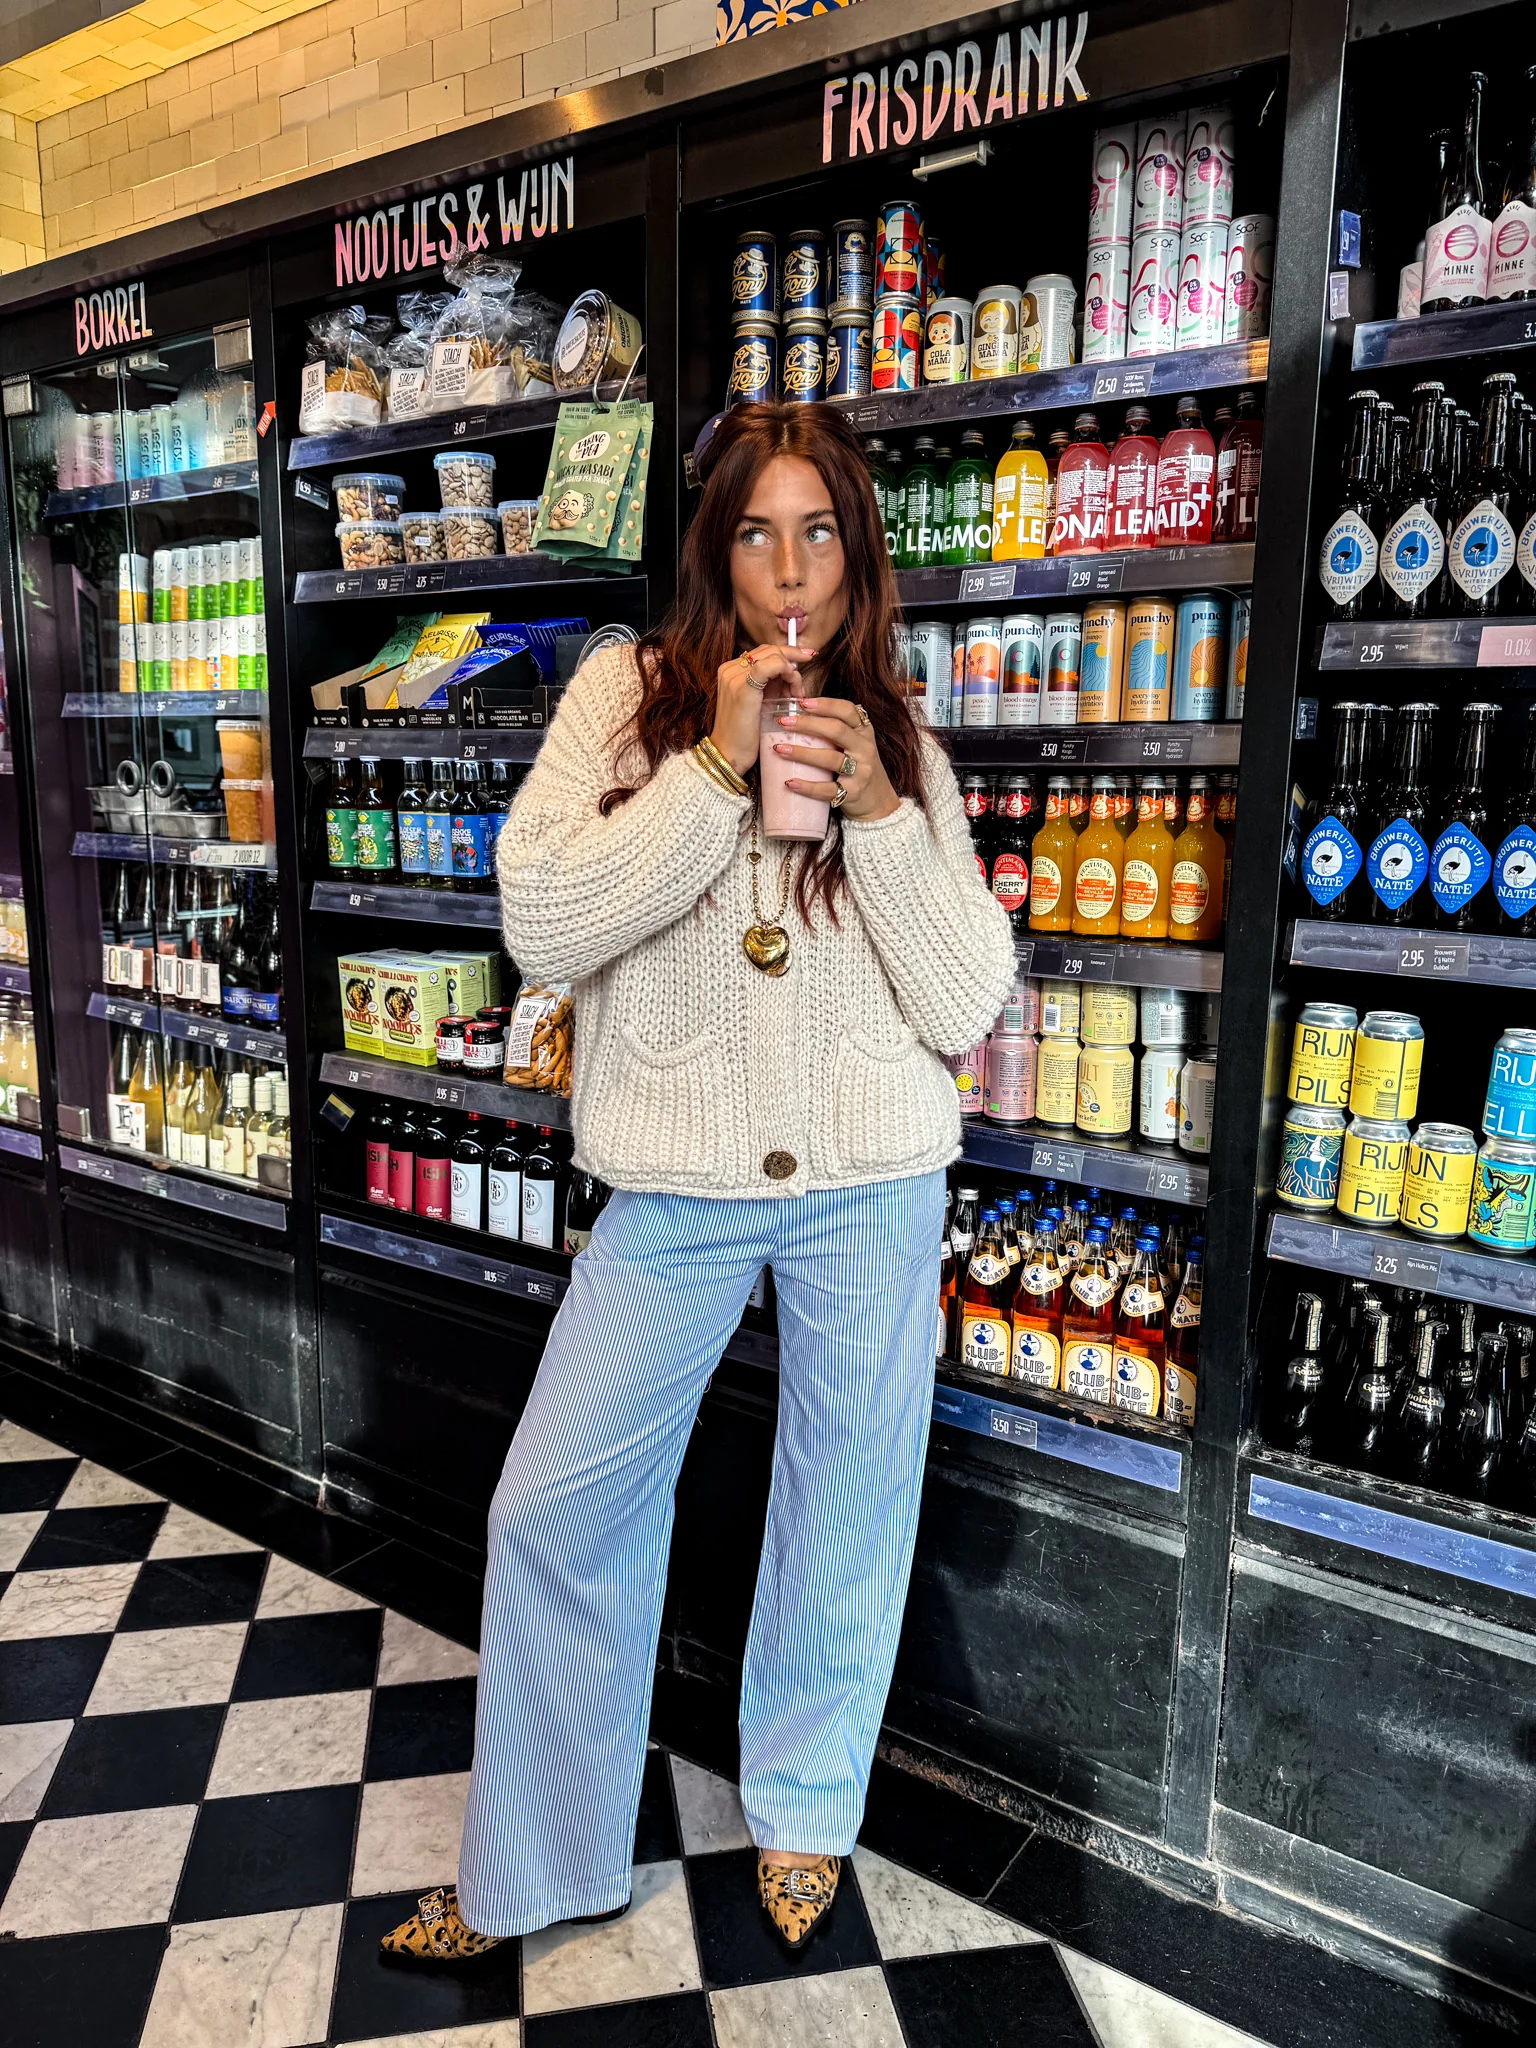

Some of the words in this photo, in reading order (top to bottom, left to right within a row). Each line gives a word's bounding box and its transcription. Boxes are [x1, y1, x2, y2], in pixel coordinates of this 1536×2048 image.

[822, 11, 1089, 163] FRISDRANK
[334, 192, 459, 287] NOOTJES
[466, 184, 490, 252] &
[1444, 264, 1474, 276] MINNE
[1494, 260, 1524, 274] MINNE
[75, 282, 152, 355] BORREL
[930, 350, 951, 358] COLA
[978, 350, 1008, 359] MAMA
[928, 357, 954, 367] MAMA
[577, 434, 606, 449] TAKING
[581, 443, 600, 458] PEA
[580, 464, 614, 477] WASABI
[1072, 572, 1091, 587] 2.99
[1326, 575, 1364, 586] VRIJWIT
[1390, 570, 1430, 581] VRIJWIT
[1458, 568, 1501, 578] VRIJWIT
[968, 577, 984, 592] 2.99
[1131, 611, 1172, 626] punchy
[419, 630, 459, 641] MEURISSE
[1005, 624, 1044, 638] punchy
[485, 632, 526, 646] MEURISSE
[1360, 644, 1384, 662] 2.95
[1504, 638, 1532, 656] 0.0%
[1041, 743, 1058, 756] 3.50
[1143, 742, 1160, 756] 3.50
[1307, 874, 1343, 887] NATTE
[1375, 878, 1413, 890] NATTE
[1433, 882, 1472, 894] NATTE
[1401, 950, 1424, 967] 2.95
[1064, 959, 1083, 974] 2.99
[383, 1018, 422, 1036] NOODLES
[1035, 1150, 1053, 1166] 2.95
[1159, 1174, 1179, 1190] 2.95
[1374, 1256, 1398, 1274] 3.25
[965, 1344, 1004, 1360] CLUB-
[1069, 1371, 1110, 1386] CLUB-
[993, 1417, 1009, 1435] 3.50
